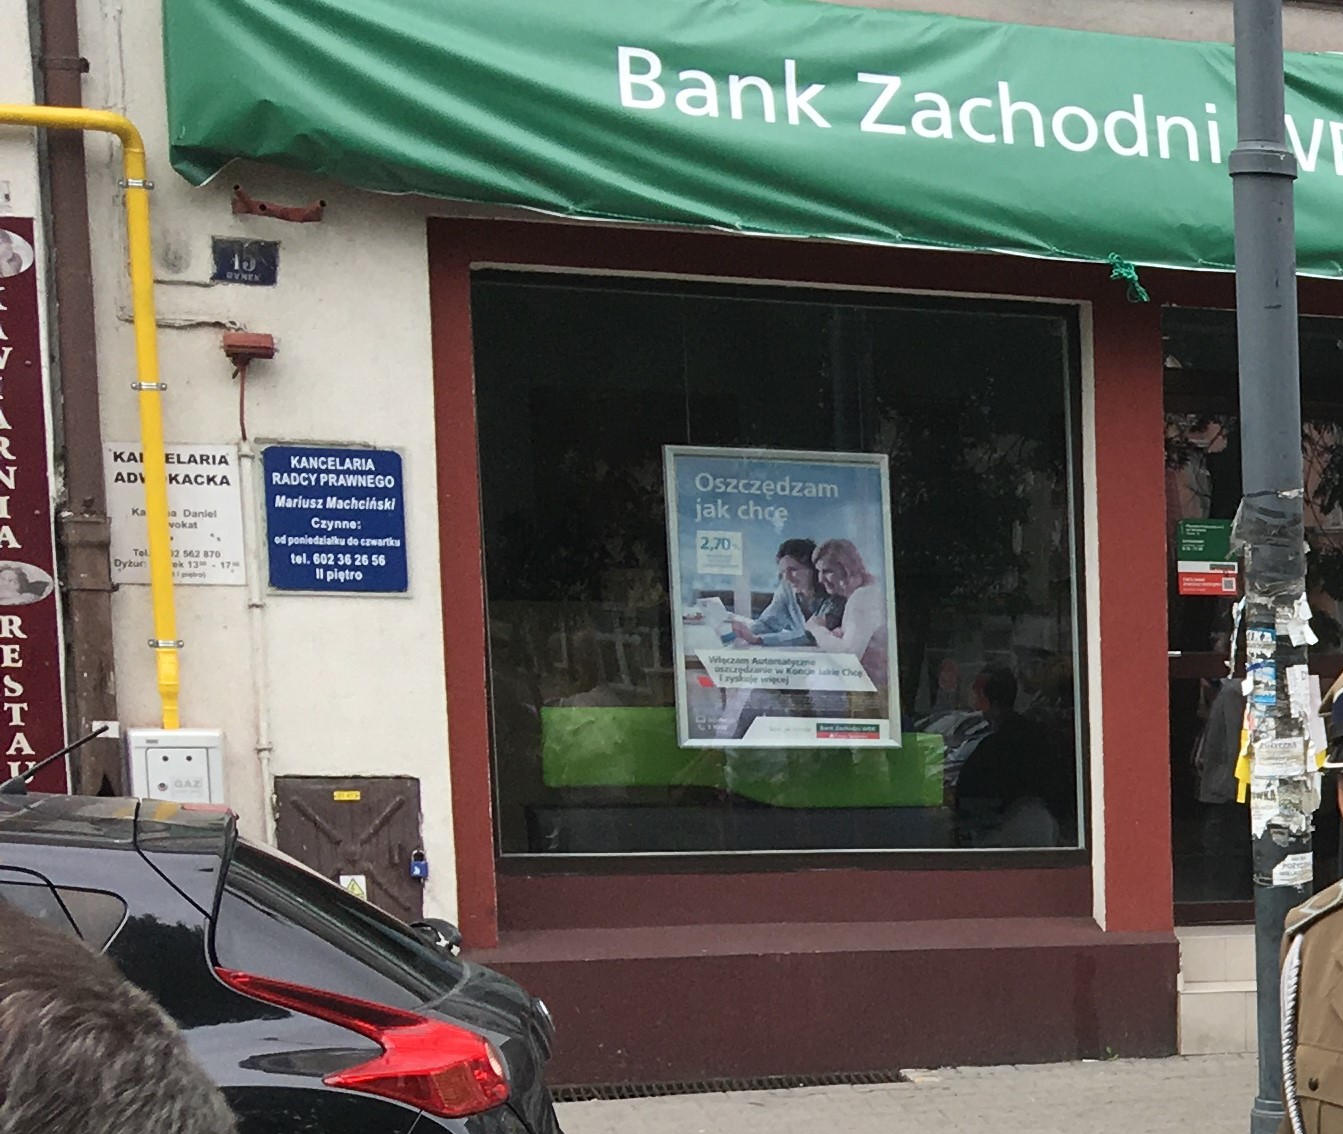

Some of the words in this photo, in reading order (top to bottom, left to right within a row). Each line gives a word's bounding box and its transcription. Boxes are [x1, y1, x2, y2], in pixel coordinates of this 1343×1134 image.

[617, 46, 831, 128] Bank
[857, 73, 1221, 164] Zachodni
[113, 451, 230, 466] KAELARIA
[291, 456, 375, 471] KANCELARIA
[272, 473, 318, 486] RADCY
[320, 474, 395, 488] PRAWNEGO
[694, 472, 839, 500] Oszczędzam
[275, 495, 323, 508] Mariusz
[326, 496, 396, 510] Machciński
[695, 498, 730, 522] jak
[183, 509, 217, 518] Daniel
[311, 517, 361, 531] Czynne:
[274, 535, 286, 545] od
[288, 535, 345, 547] poniedziałku
[347, 536, 359, 546] do
[360, 537, 401, 547] czwartku
[291, 553, 311, 565] tel.
[313, 553, 335, 565] 602
[337, 554, 352, 565] 36
[354, 554, 369, 565] 26
[371, 555, 386, 566] 56
[326, 569, 363, 582] piętro
